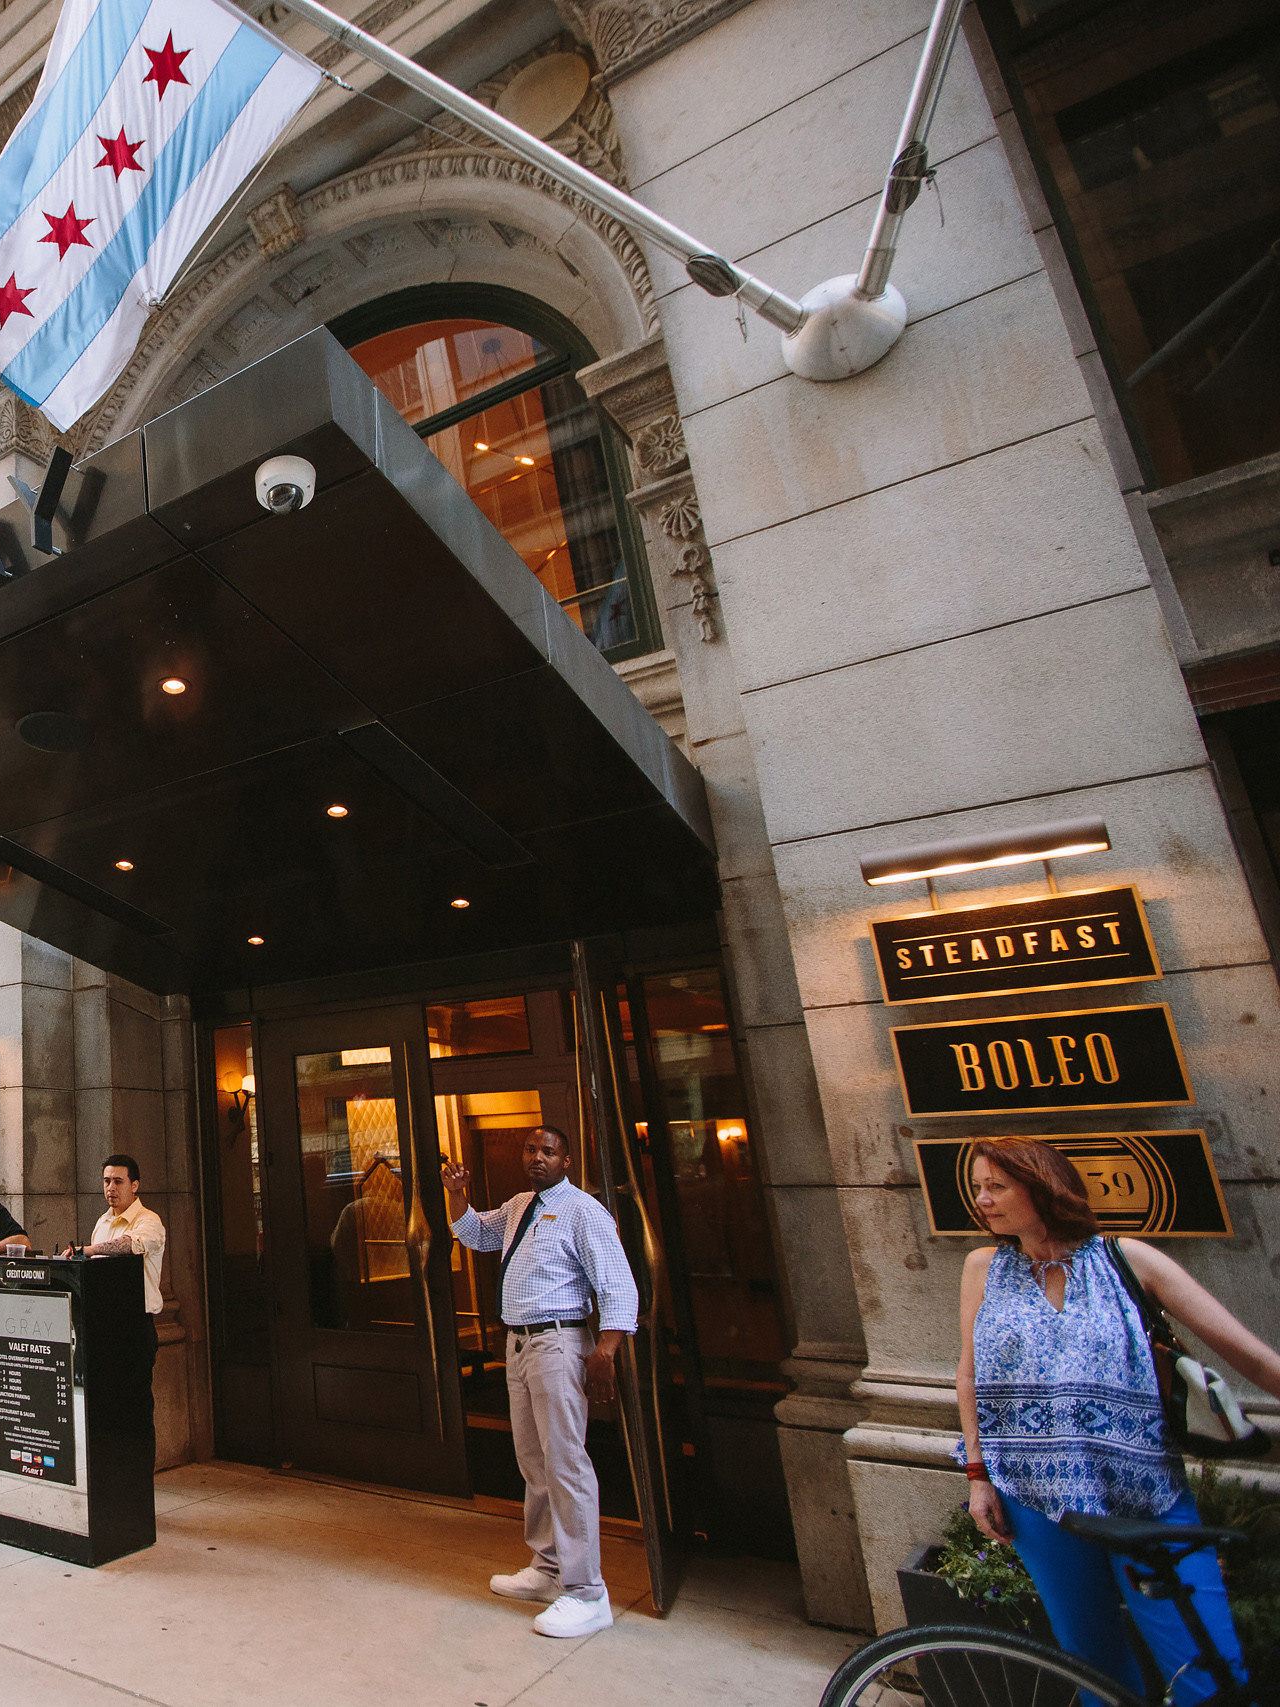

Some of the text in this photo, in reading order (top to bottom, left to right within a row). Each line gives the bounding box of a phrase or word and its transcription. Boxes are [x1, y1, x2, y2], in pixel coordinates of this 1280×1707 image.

[896, 922, 1122, 970] STEADFAST
[950, 1033, 1119, 1092] BOLEO
[6, 1269, 45, 1279] CREDIT CARD ONLY
[5, 1318, 52, 1336] GRAY
[8, 1342, 51, 1354] VALET RATES
[8, 1355, 30, 1363] OVERNIGHT
[31, 1428, 50, 1436] INCLUDED
[22, 1465, 44, 1476] PARK 1
